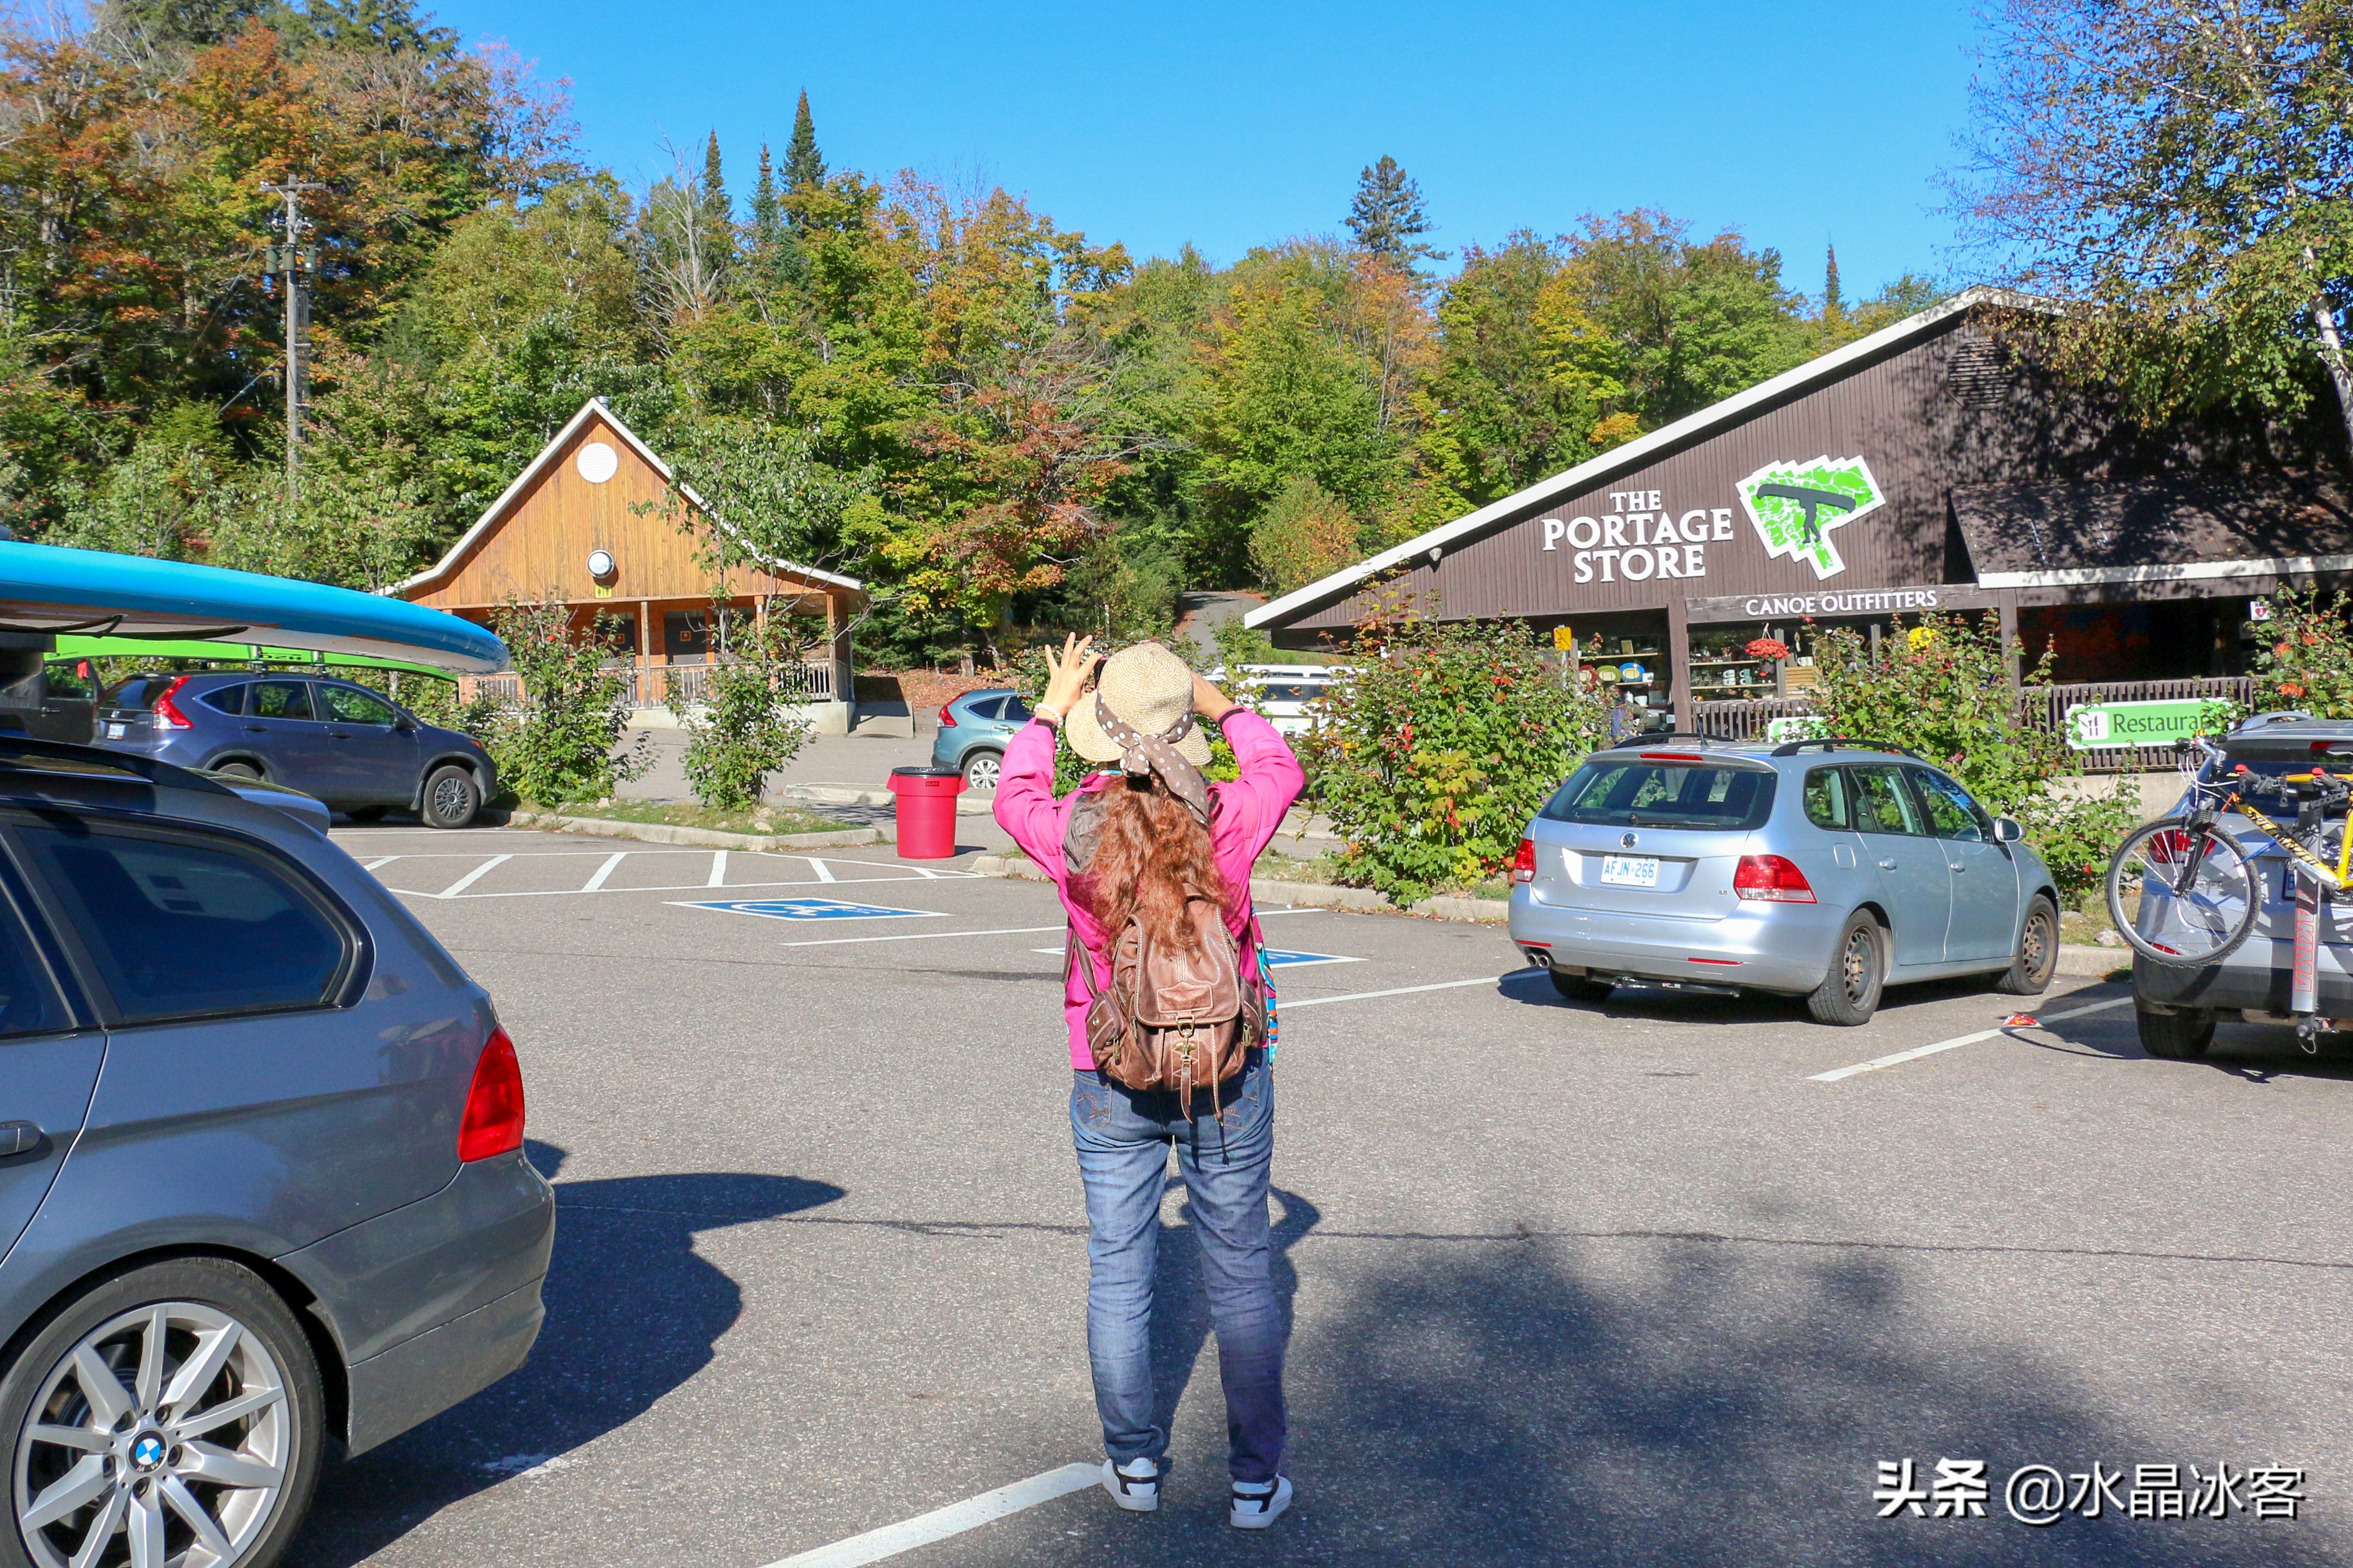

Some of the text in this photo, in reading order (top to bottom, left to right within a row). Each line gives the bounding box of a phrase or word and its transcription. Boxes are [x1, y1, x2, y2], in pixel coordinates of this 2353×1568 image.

[1609, 490, 1662, 513] THE
[1541, 508, 1734, 551] PORTAGE
[1574, 545, 1705, 584] STORE
[1745, 590, 1937, 616] CANOE OUTFITTERS
[2113, 713, 2222, 733] Restauran
[2294, 889, 2316, 992] YAKIMA
